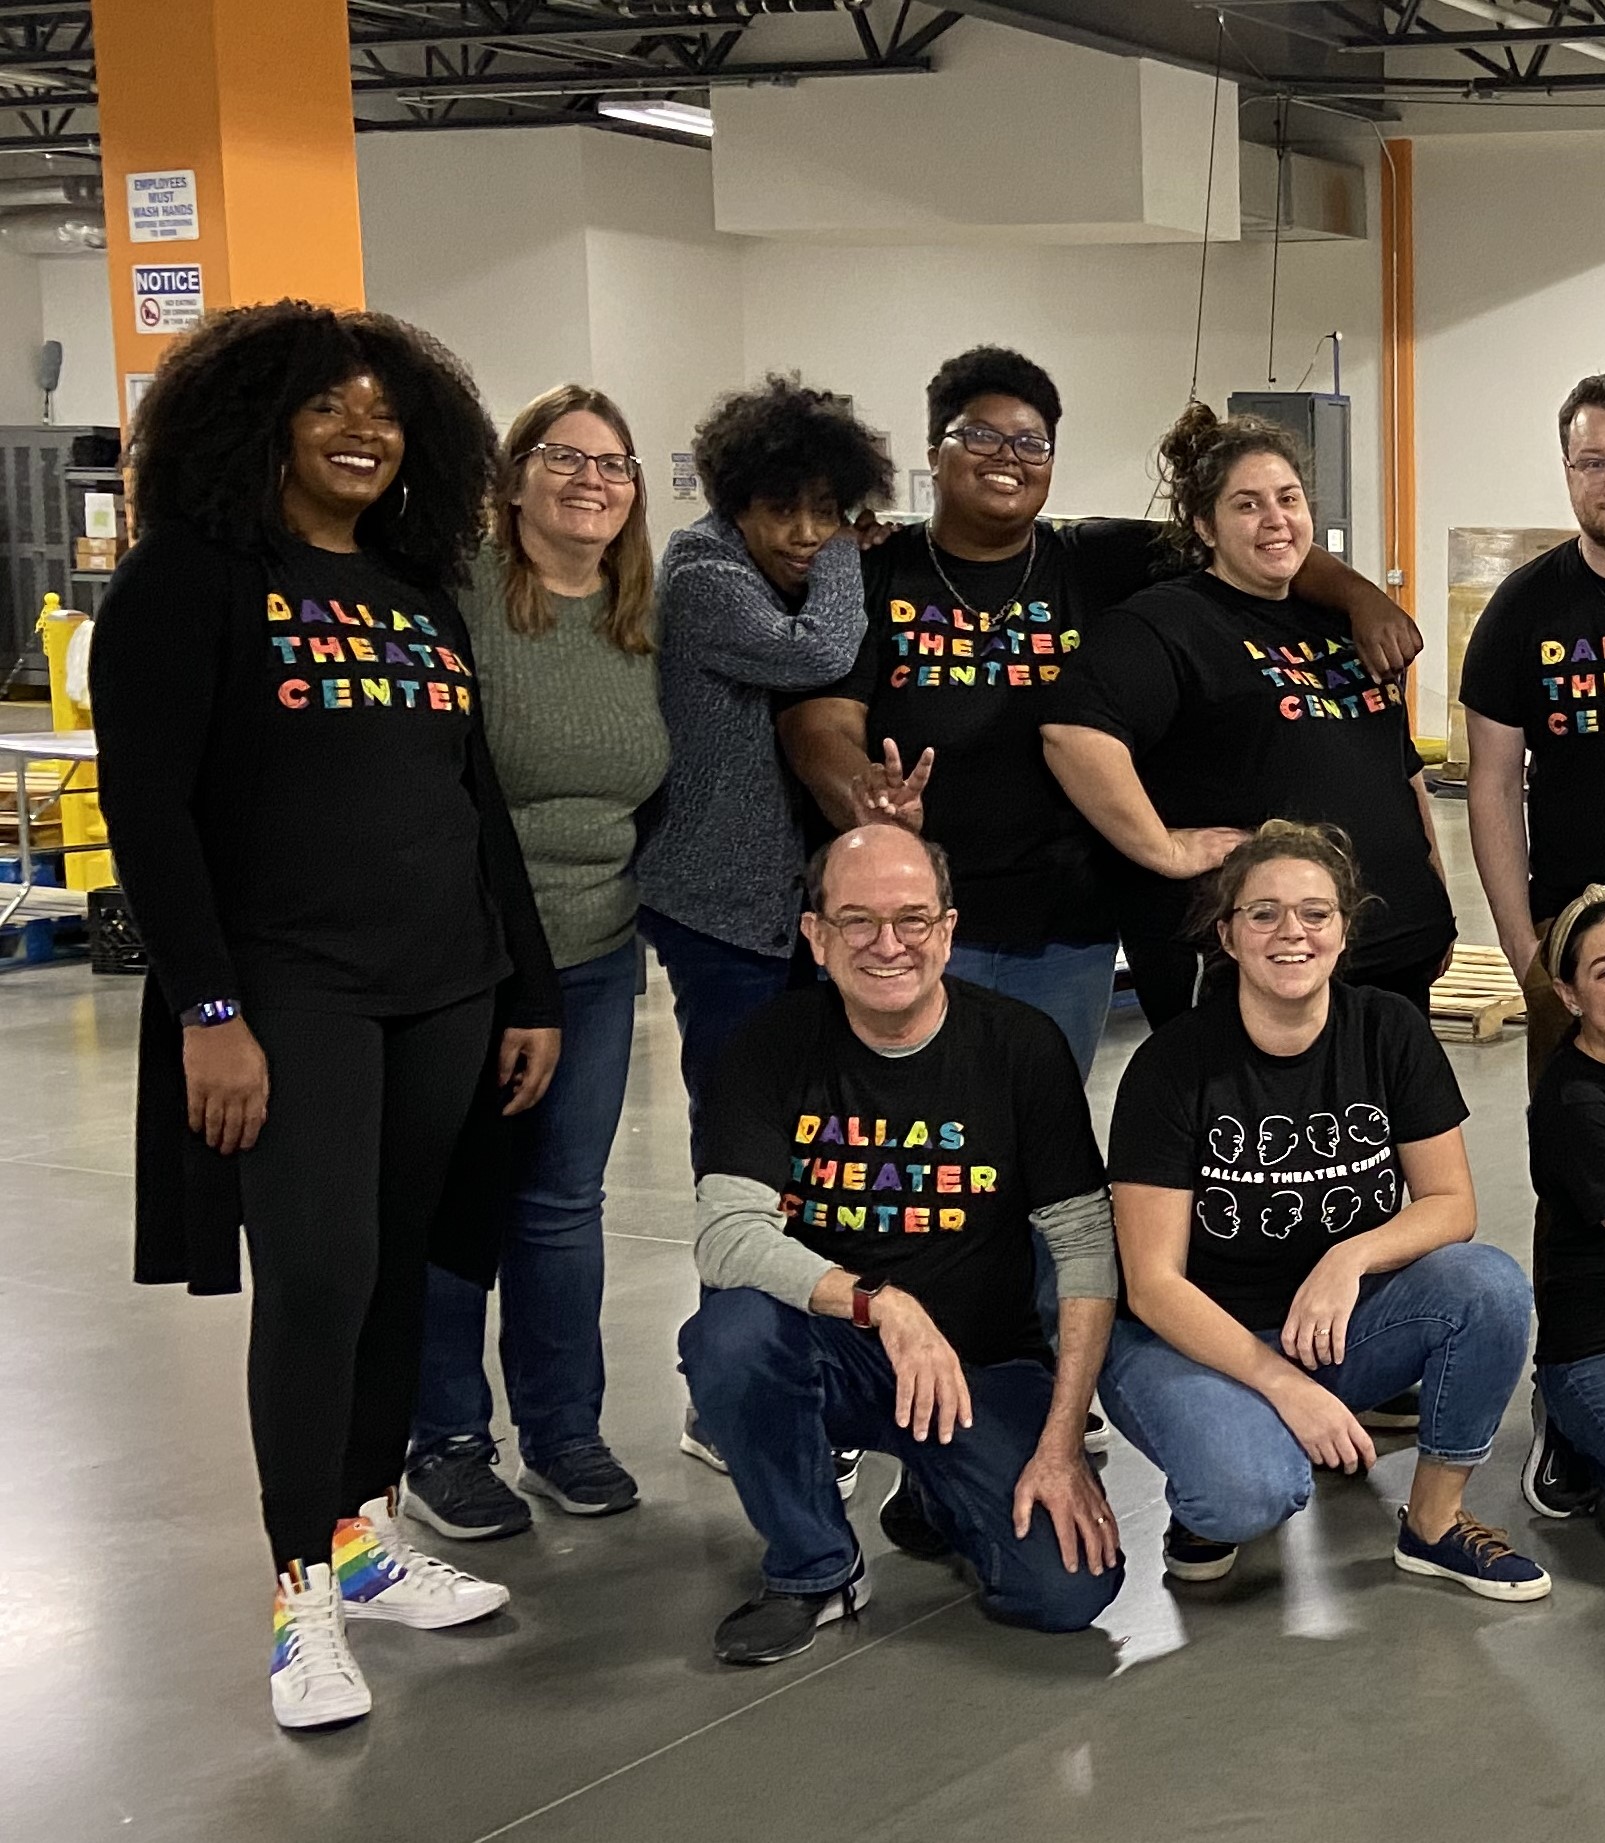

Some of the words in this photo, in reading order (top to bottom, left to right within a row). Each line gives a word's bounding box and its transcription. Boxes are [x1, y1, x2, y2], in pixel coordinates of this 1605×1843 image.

[134, 177, 187, 191] EMPLOYEES
[148, 191, 175, 203] MUST
[132, 206, 159, 218] WASH
[162, 204, 193, 217] HANDS
[136, 271, 200, 291] NOTICE
[266, 592, 438, 637] DALLAS
[889, 599, 1052, 633] DALLAS
[891, 628, 1082, 658] THEATER
[890, 660, 1062, 689] CENTER
[1260, 658, 1367, 690] THEAT
[277, 677, 472, 716] CENTER
[1279, 683, 1402, 721] CENTER
[795, 1114, 966, 1150] DALLAS
[790, 1156, 998, 1194] THEATER
[1201, 1165, 1265, 1184] DALLAS
[1270, 1165, 1348, 1184] THEATER
[1351, 1146, 1391, 1174] CENTER
[781, 1192, 967, 1234] CENTER
